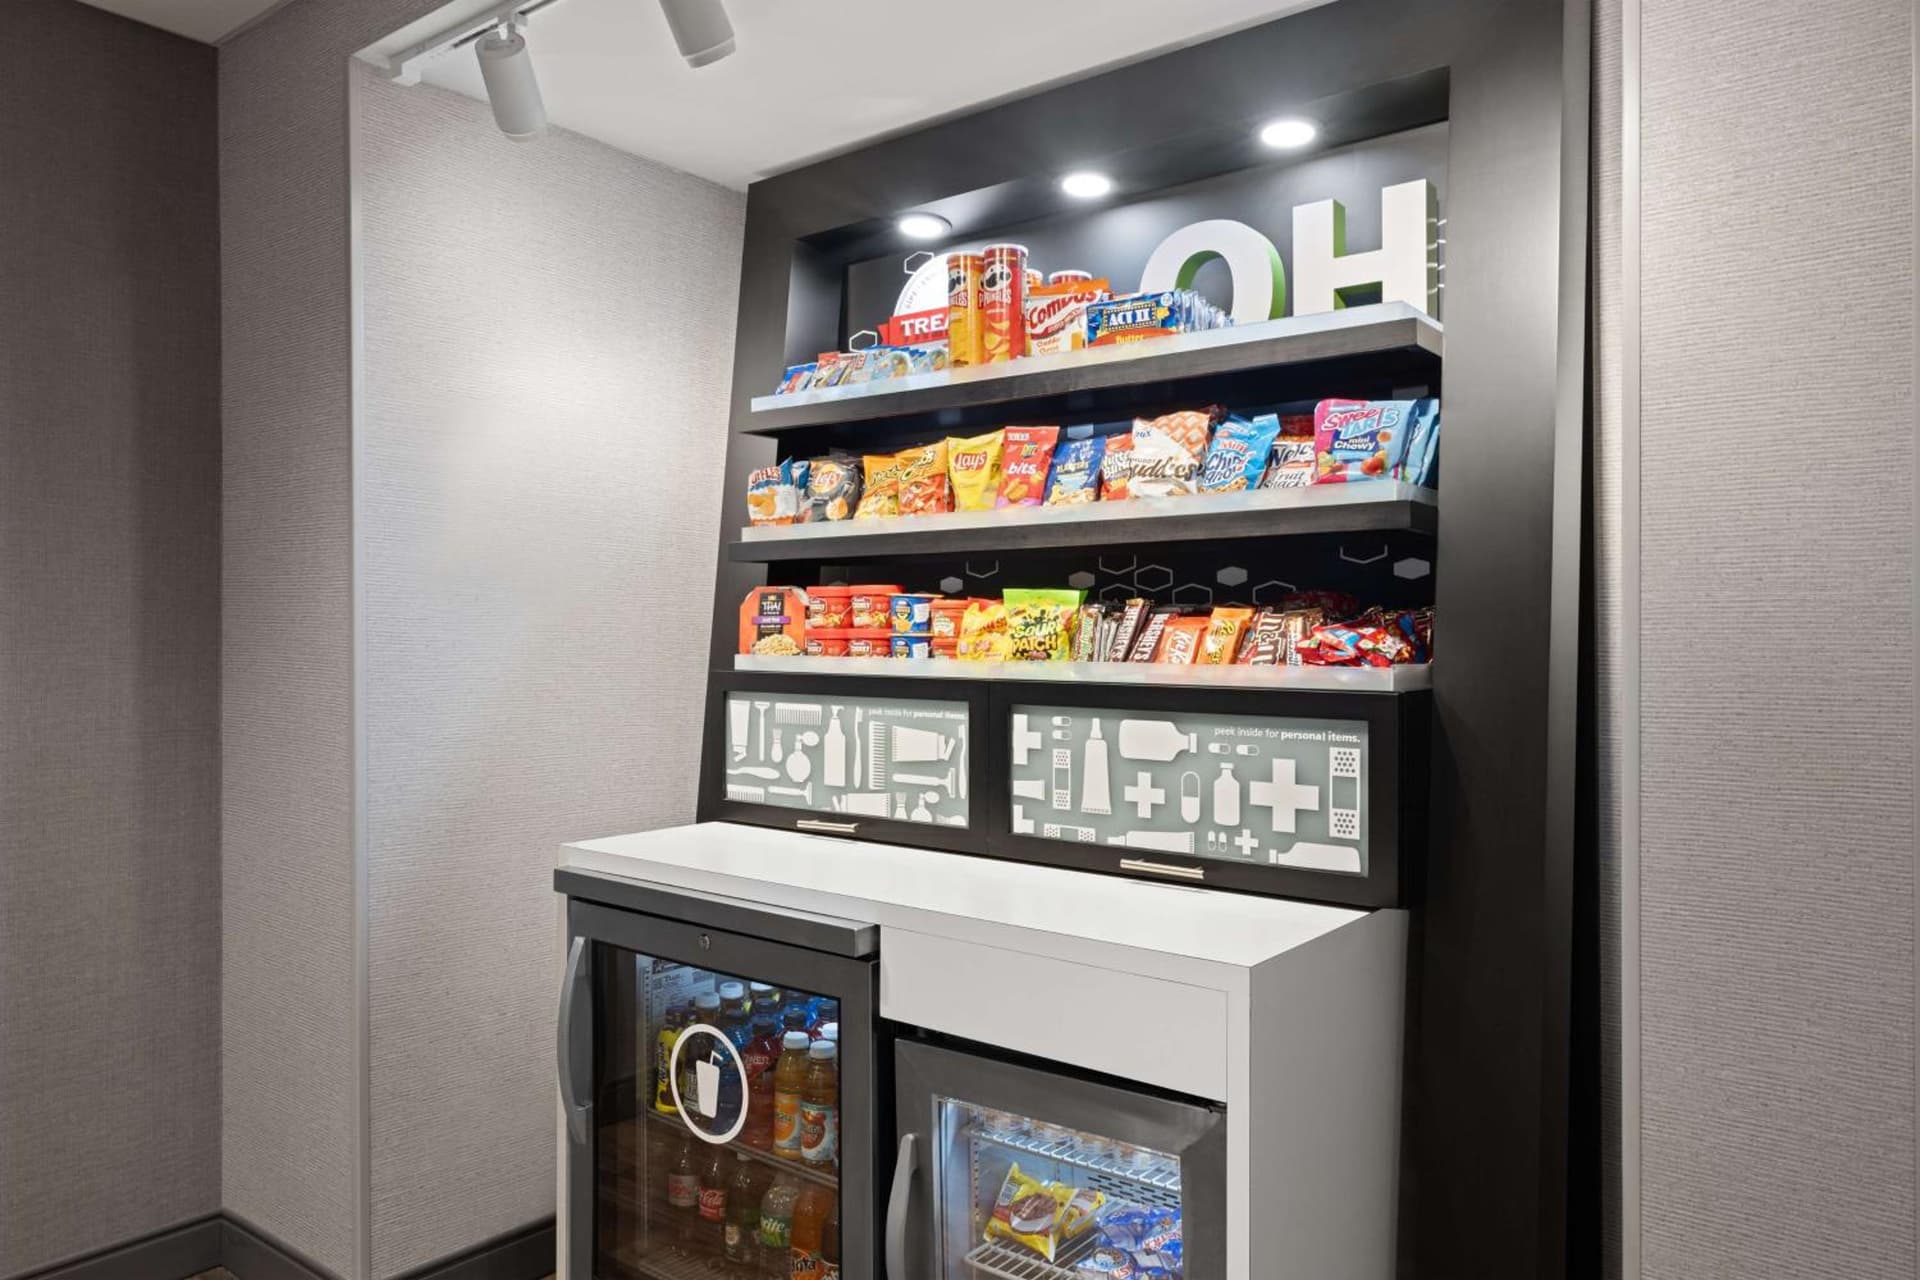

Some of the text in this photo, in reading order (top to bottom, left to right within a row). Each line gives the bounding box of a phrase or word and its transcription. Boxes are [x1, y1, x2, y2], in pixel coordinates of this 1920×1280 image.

[1334, 440, 1376, 451] Chewy
[1007, 461, 1037, 474] bits
[1012, 634, 1059, 655] PATCH
[1214, 727, 1361, 743] peek inside for personal items.
